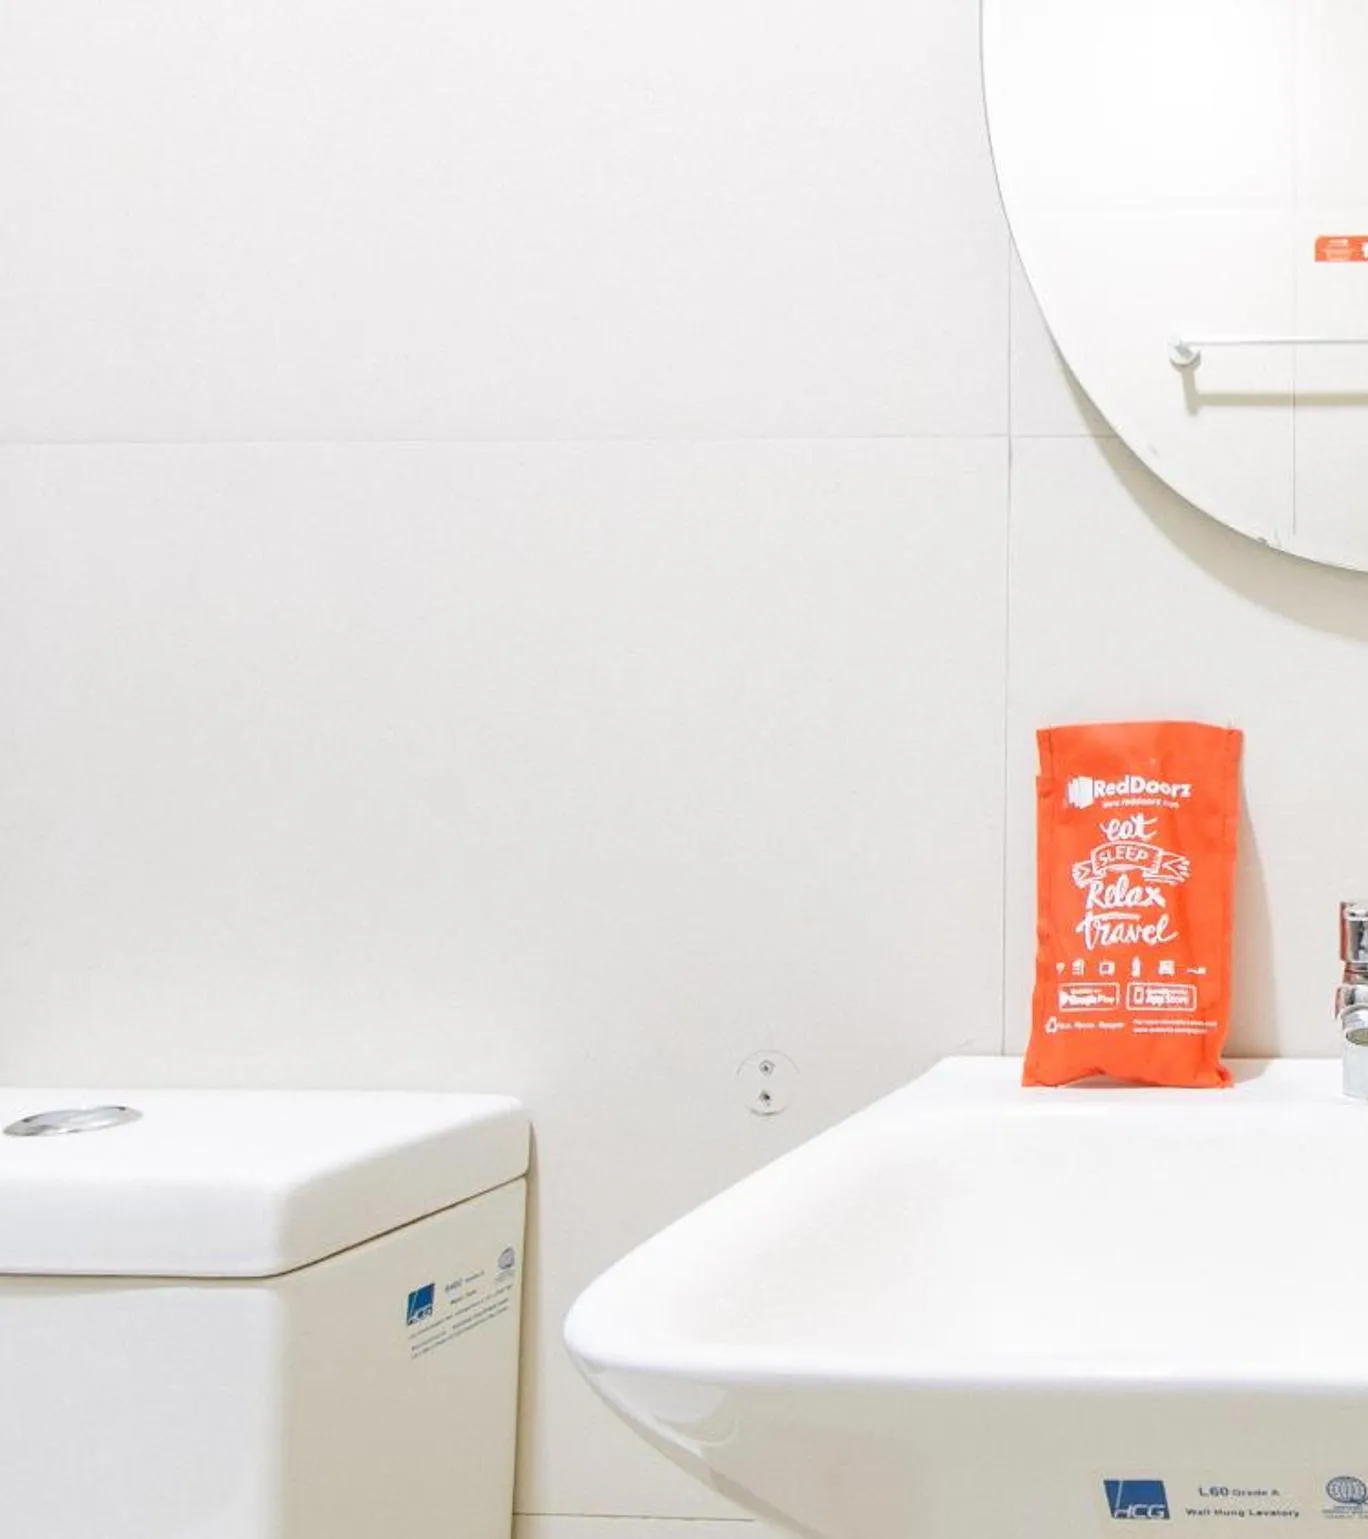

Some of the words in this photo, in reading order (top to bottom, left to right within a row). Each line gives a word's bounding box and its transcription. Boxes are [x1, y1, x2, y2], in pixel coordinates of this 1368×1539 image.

[1094, 775, 1192, 798] RedDoorz
[1100, 813, 1158, 842] eat
[1099, 846, 1149, 865] SLEEP
[1085, 873, 1167, 909] Relax
